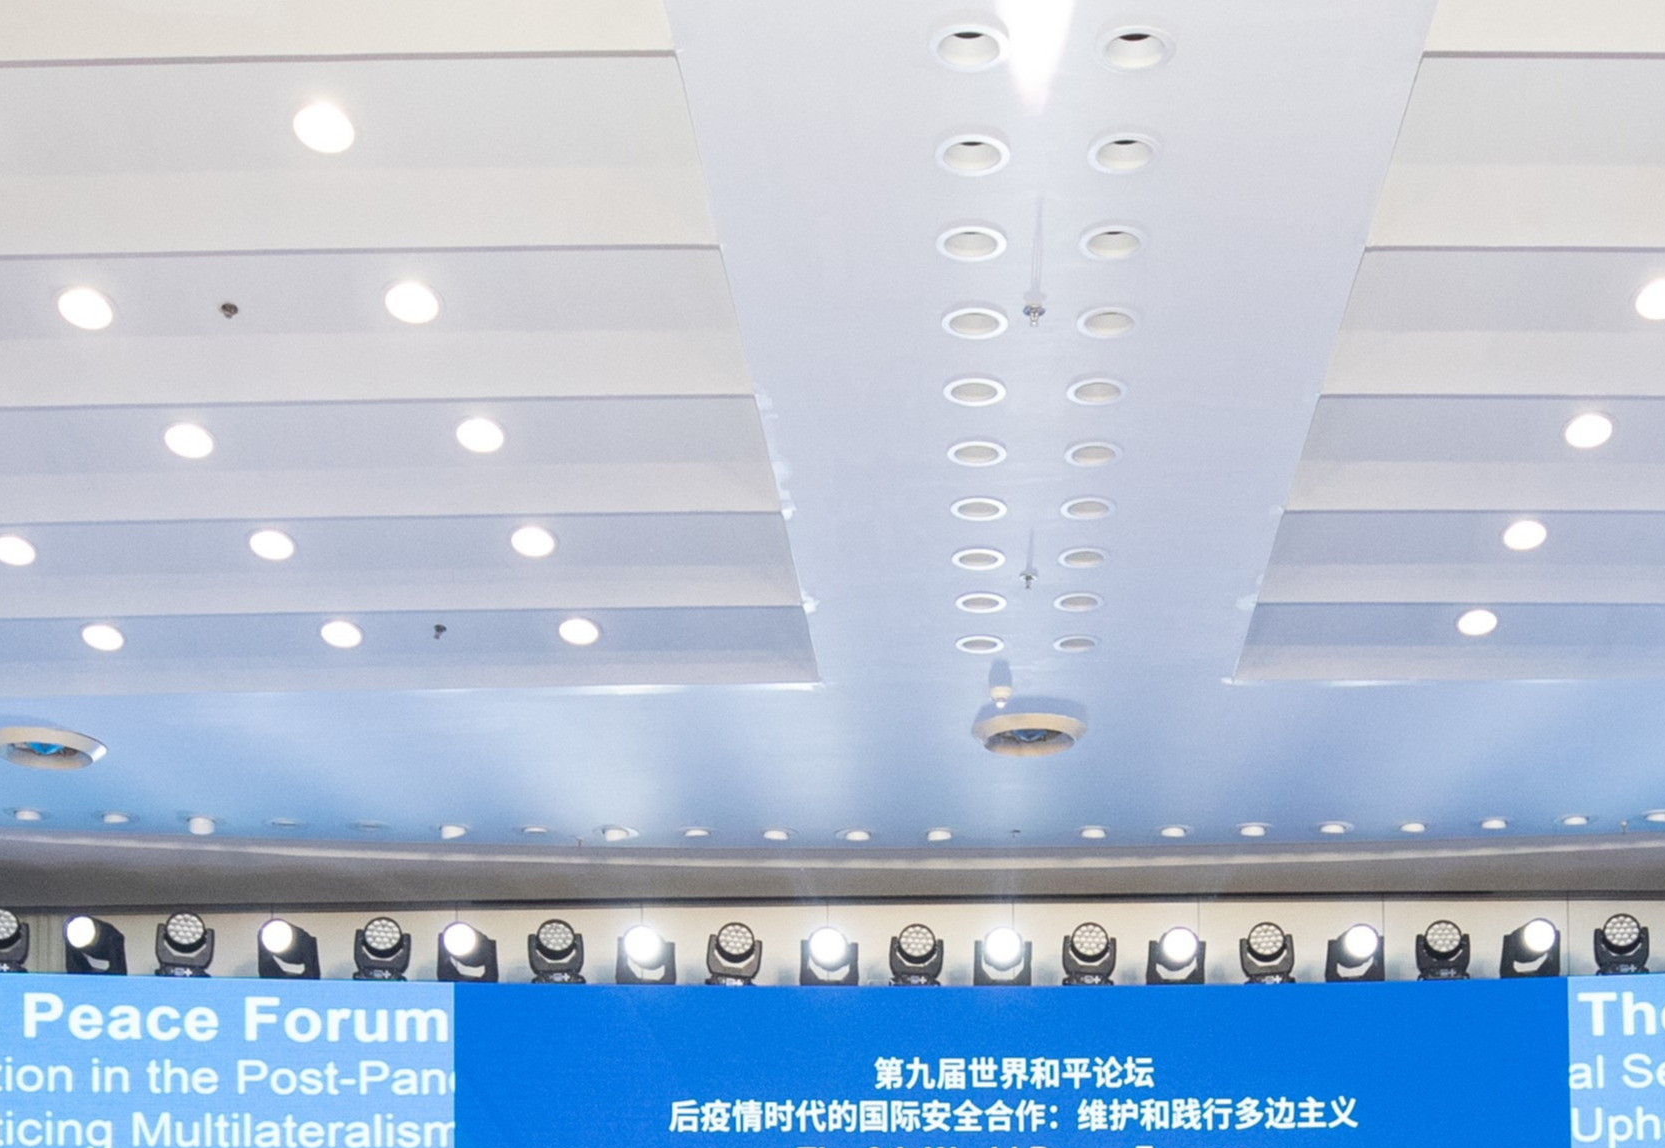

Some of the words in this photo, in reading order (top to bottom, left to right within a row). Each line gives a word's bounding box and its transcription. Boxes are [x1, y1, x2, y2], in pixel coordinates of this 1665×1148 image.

[23, 991, 220, 1041] Peace
[244, 995, 449, 1043] Forum
[91, 1057, 131, 1094] in
[146, 1058, 220, 1096] the
[874, 1056, 1155, 1090] 第九届世界和平论坛
[668, 1096, 1360, 1134] 后疫情时代的国际安全合作：维护和践行多边主义
